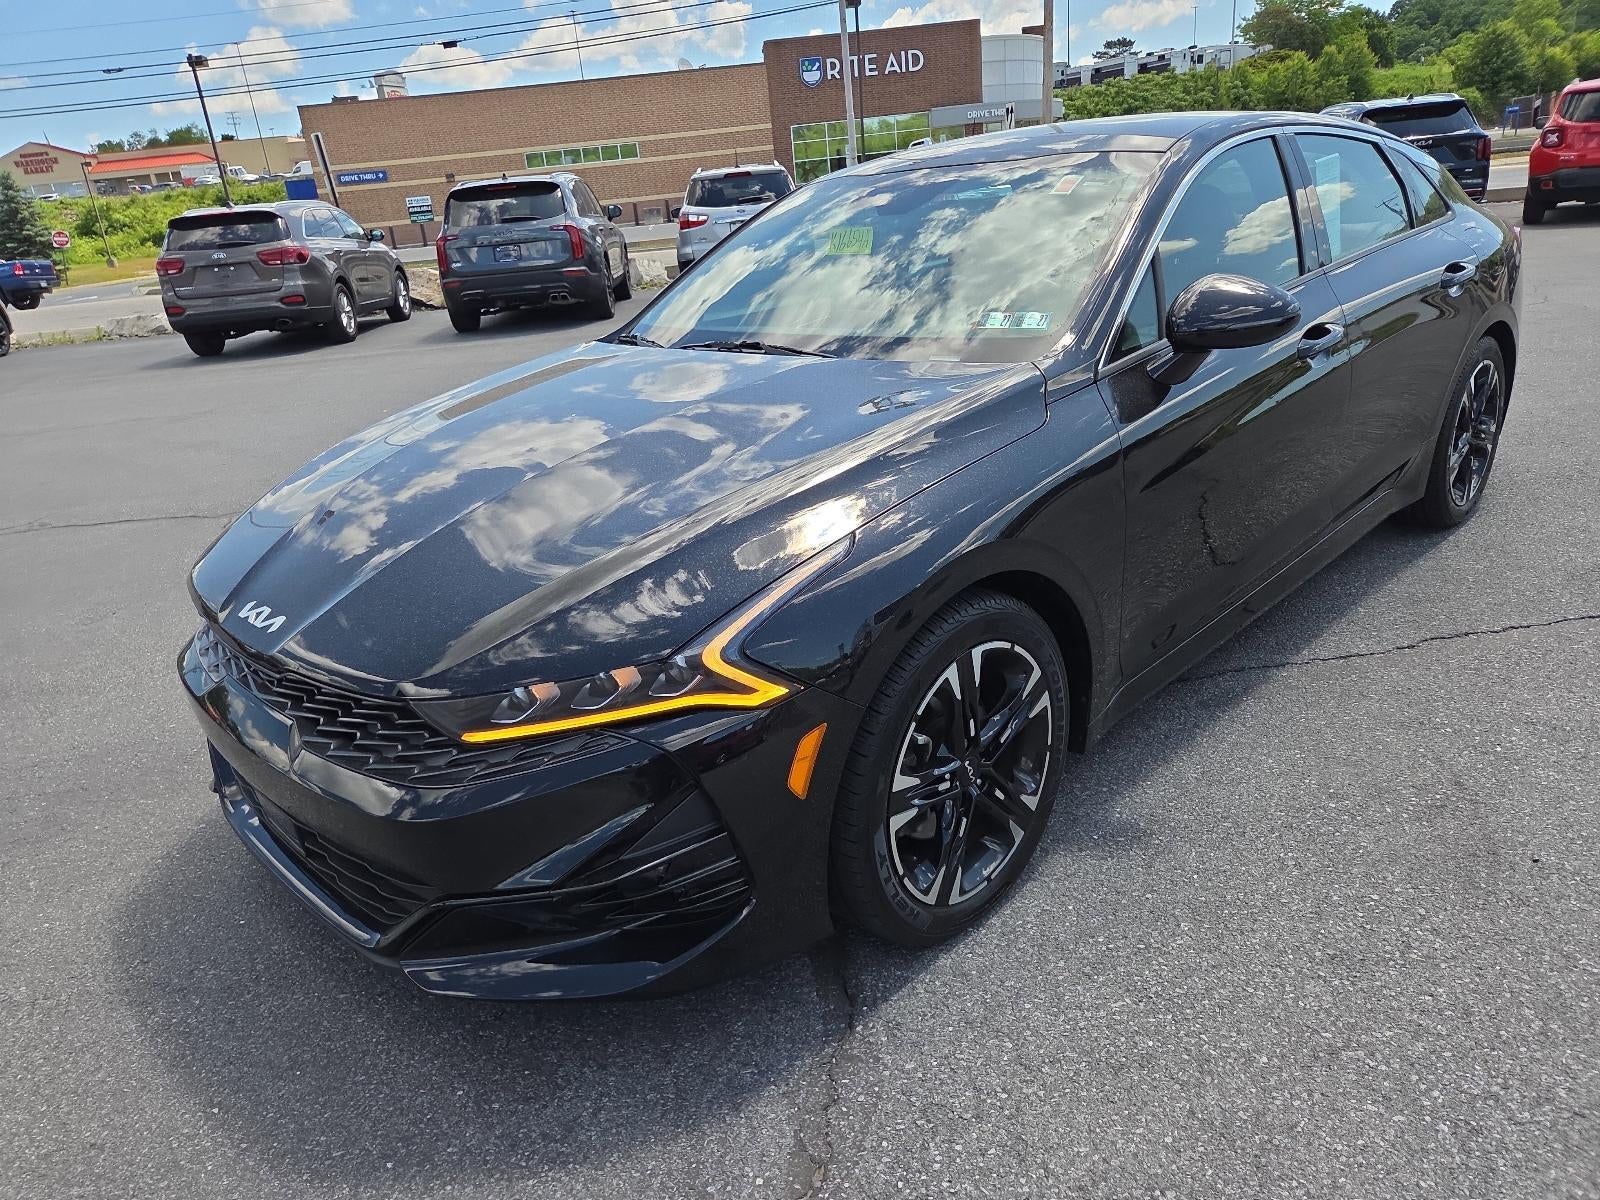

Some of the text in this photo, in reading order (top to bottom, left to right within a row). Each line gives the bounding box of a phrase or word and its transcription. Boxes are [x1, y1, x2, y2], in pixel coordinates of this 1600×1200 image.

[826, 50, 924, 80] RTE AID
[967, 108, 1005, 119] DRIVE THR
[340, 172, 376, 182] DRIVE THRU
[1000, 314, 1012, 328] 27
[1036, 314, 1049, 327] 27
[238, 600, 287, 634] KIA
